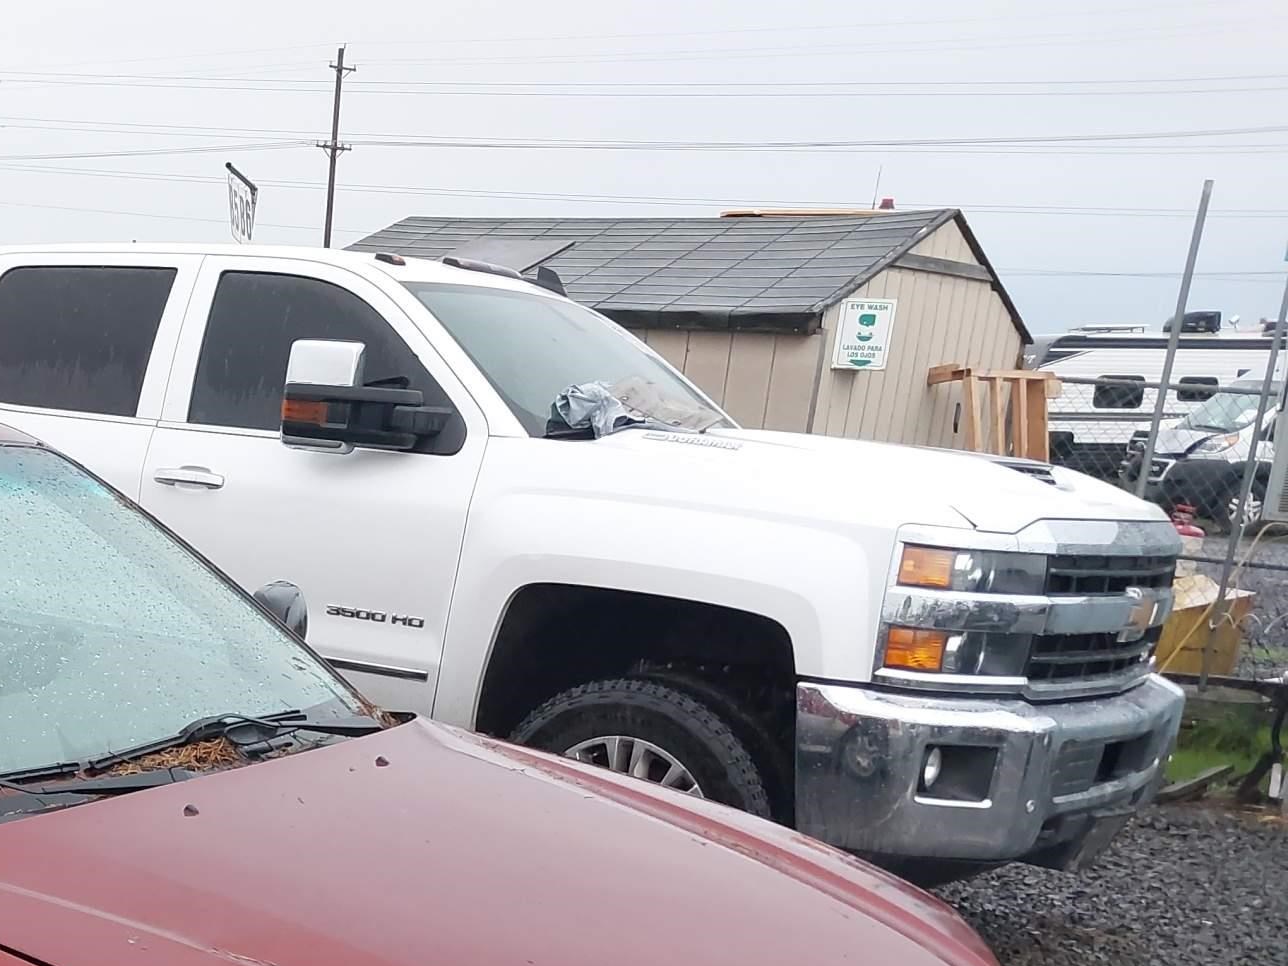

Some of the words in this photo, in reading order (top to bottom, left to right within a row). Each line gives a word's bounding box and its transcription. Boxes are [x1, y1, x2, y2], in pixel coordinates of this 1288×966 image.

[850, 303, 865, 311] EYE
[867, 303, 889, 311] WASH
[842, 344, 866, 352] LAVADO
[325, 604, 387, 623] 3500
[391, 613, 425, 629] HD
